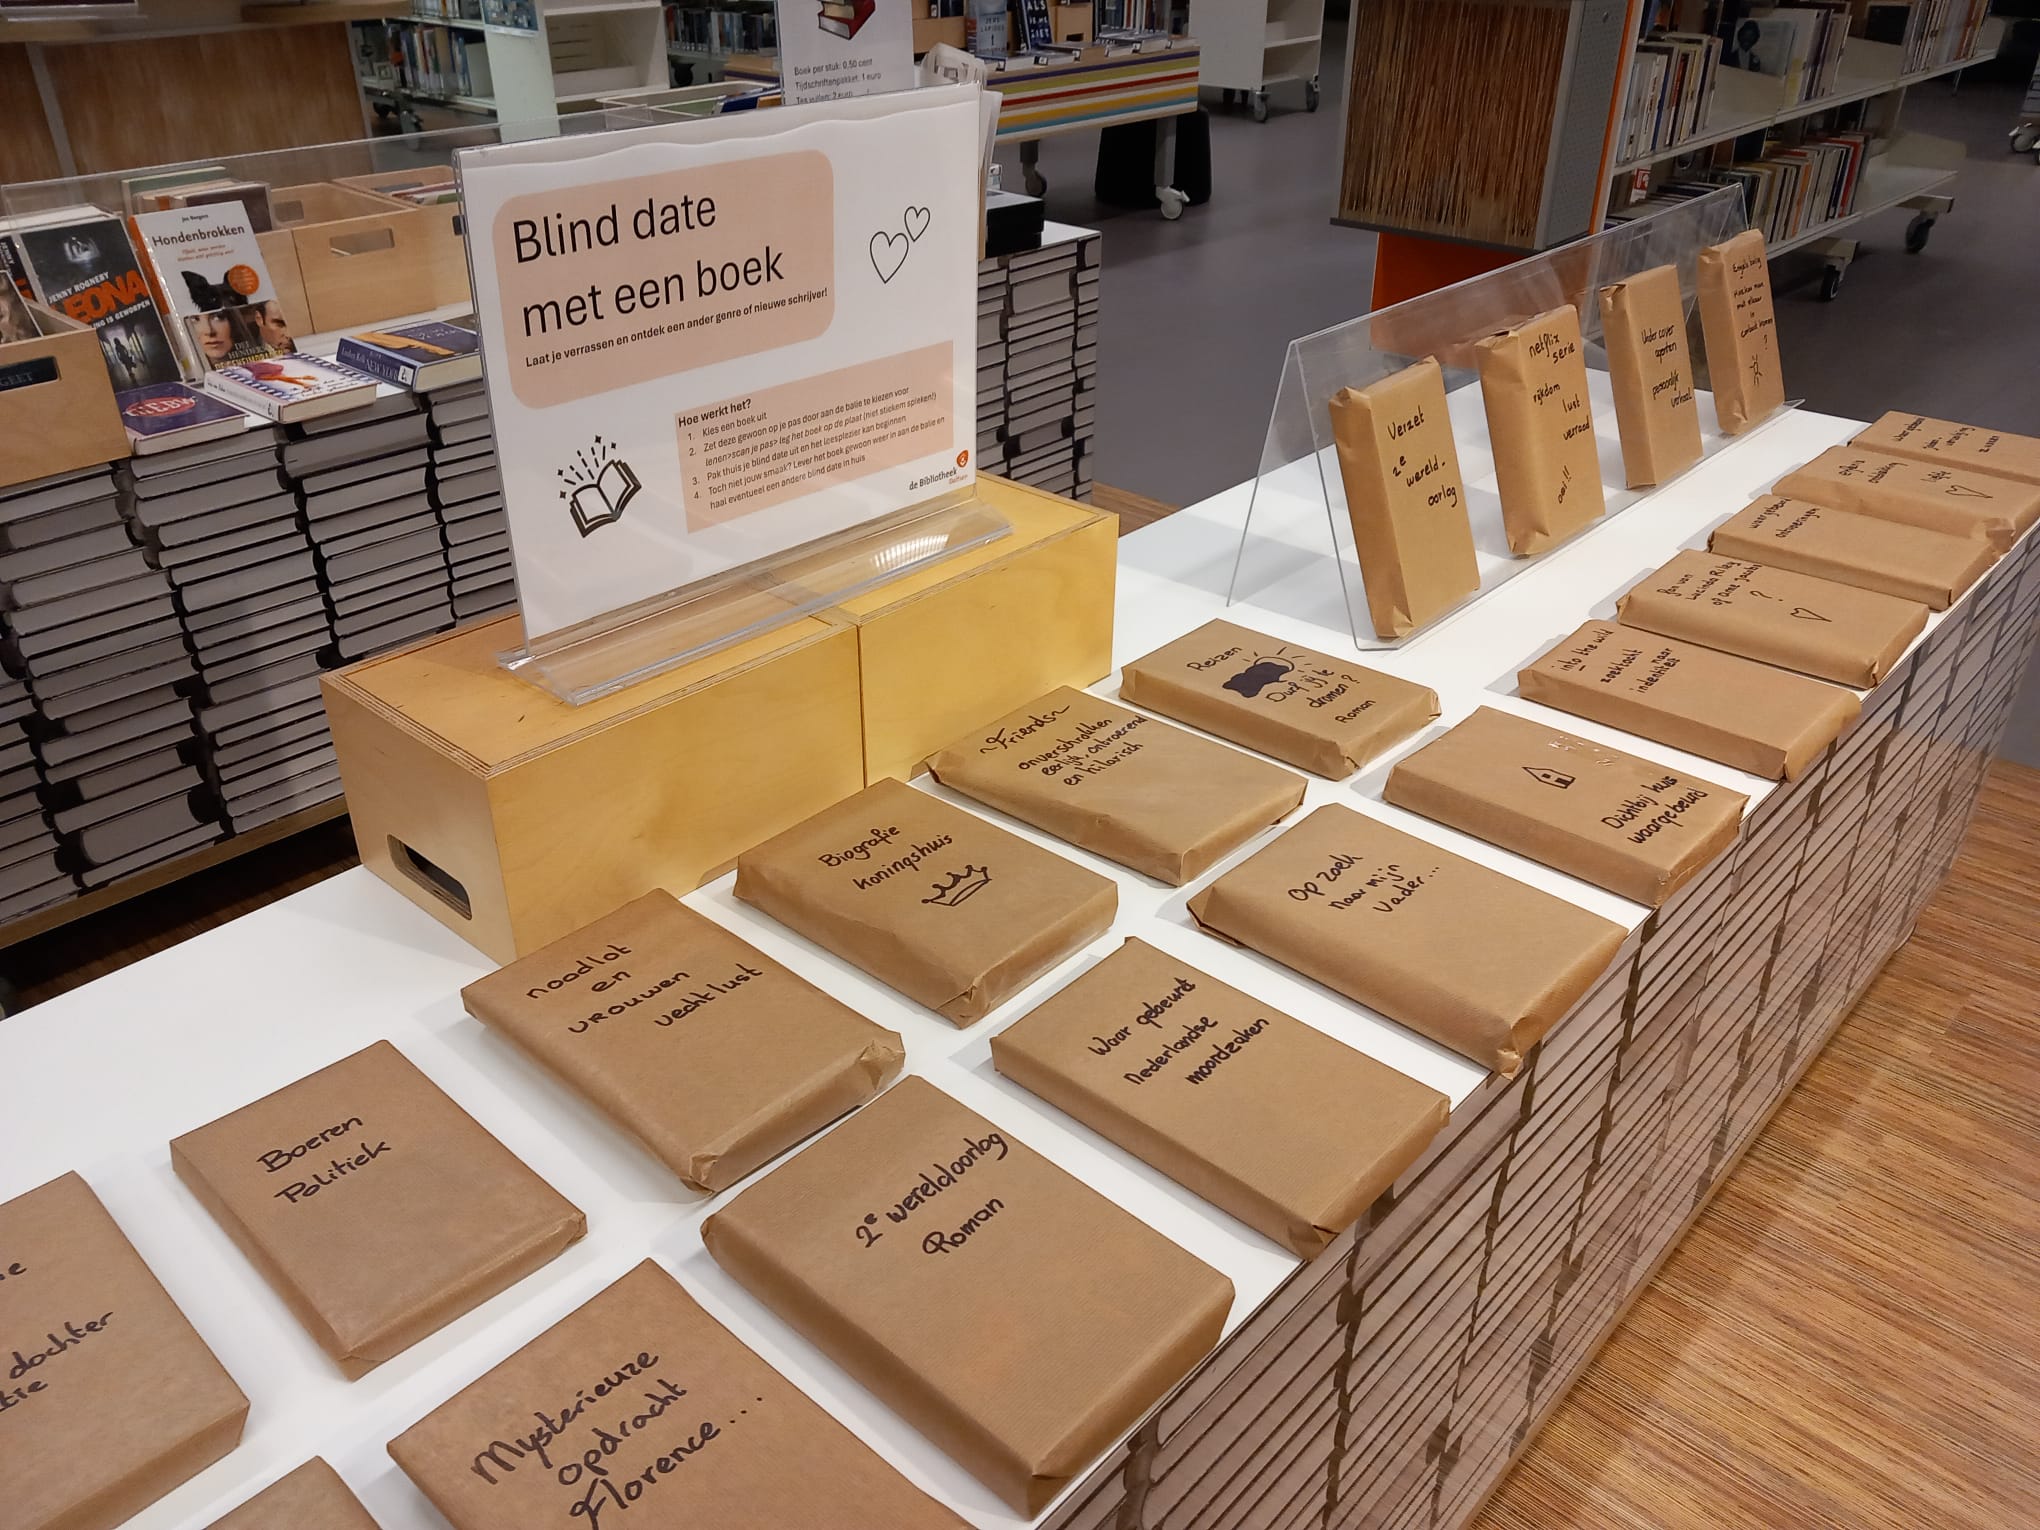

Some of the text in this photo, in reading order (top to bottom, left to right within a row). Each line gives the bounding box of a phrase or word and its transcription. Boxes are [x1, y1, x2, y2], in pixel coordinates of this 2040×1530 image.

[794, 65, 811, 76] Boek
[152, 224, 245, 247] Hondenbrokken
[513, 195, 716, 263] Blind date
[48, 271, 109, 304] JENNY ROGNEBY
[50, 269, 148, 325] EONA
[523, 246, 784, 336] met een boek
[526, 288, 828, 367] Laat je verrassen en ontdek een ander genre of nieuwe schrijver!
[1528, 332, 1560, 358] netflix
[1553, 342, 1575, 364] serie
[678, 398, 751, 428] Hoe werkt het?
[704, 441, 716, 452] Zet
[718, 436, 736, 448] deze
[738, 428, 767, 443] gewoon
[769, 423, 778, 433] op
[779, 420, 786, 431] je
[788, 418, 801, 429] pas
[802, 411, 819, 423] door
[821, 408, 834, 418] aan
[835, 405, 844, 414] de
[845, 400, 863, 412] balie
[864, 398, 871, 406] te
[872, 392, 893, 405] kiezen
[895, 387, 909, 397] voor
[1387, 404, 1424, 440] Verzet
[1562, 393, 1580, 413] lust
[702, 424, 719, 437] Kies
[721, 422, 735, 432] een
[736, 415, 756, 427] boek
[757, 412, 767, 421] uit
[751, 444, 759, 455] je
[779, 436, 791, 446] leg
[791, 430, 804, 441] het
[804, 425, 822, 437] boek
[824, 423, 833, 433] op
[834, 419, 843, 429] de
[844, 414, 863, 427] plaat
[863, 408, 879, 421] (niet
[1563, 415, 1590, 441] verraad
[708, 483, 727, 496] Toch
[728, 478, 743, 489] niet
[744, 473, 762, 486] jouw
[763, 462, 792, 478] smaak?
[793, 456, 812, 469] Lever
[813, 454, 826, 464] het
[826, 447, 844, 459] boek
[845, 440, 872, 455] gewoon
[872, 434, 889, 444] weer
[890, 430, 896, 439] in
[897, 428, 910, 438] aan
[910, 423, 919, 433] de
[920, 419, 936, 430] balie
[937, 416, 945, 425] en
[909, 480, 918, 490] de
[919, 467, 958, 487] Bibliotheek
[1428, 484, 1457, 508] oorlog
[1186, 646, 1243, 672] Reizen
[1571, 643, 1598, 656] the
[1600, 648, 1643, 684] zoektocht
[1650, 647, 1673, 664] naar
[1334, 699, 1376, 724] Roman
[1087, 714, 1149, 754] ontroerend
[1063, 741, 1144, 786] en hilarisch
[1640, 775, 1678, 793] huis
[818, 826, 900, 867] Biografie
[1287, 854, 1364, 901] Op zoek
[1328, 864, 1405, 910] naar mijn
[526, 944, 632, 999] noodlot
[591, 971, 632, 992] en
[1087, 977, 1196, 1056] Waar gebeurd
[1185, 1018, 1270, 1085] moordzaken
[256, 1115, 363, 1173] Boeren
[274, 1140, 391, 1203] Politiek
[886, 1132, 1009, 1225] wereldoorlog
[921, 1197, 1004, 1255] Roman
[9, 1311, 114, 1379] dochter
[471, 1351, 659, 1485] Mysterieuze
[557, 1378, 687, 1486] opdracht
